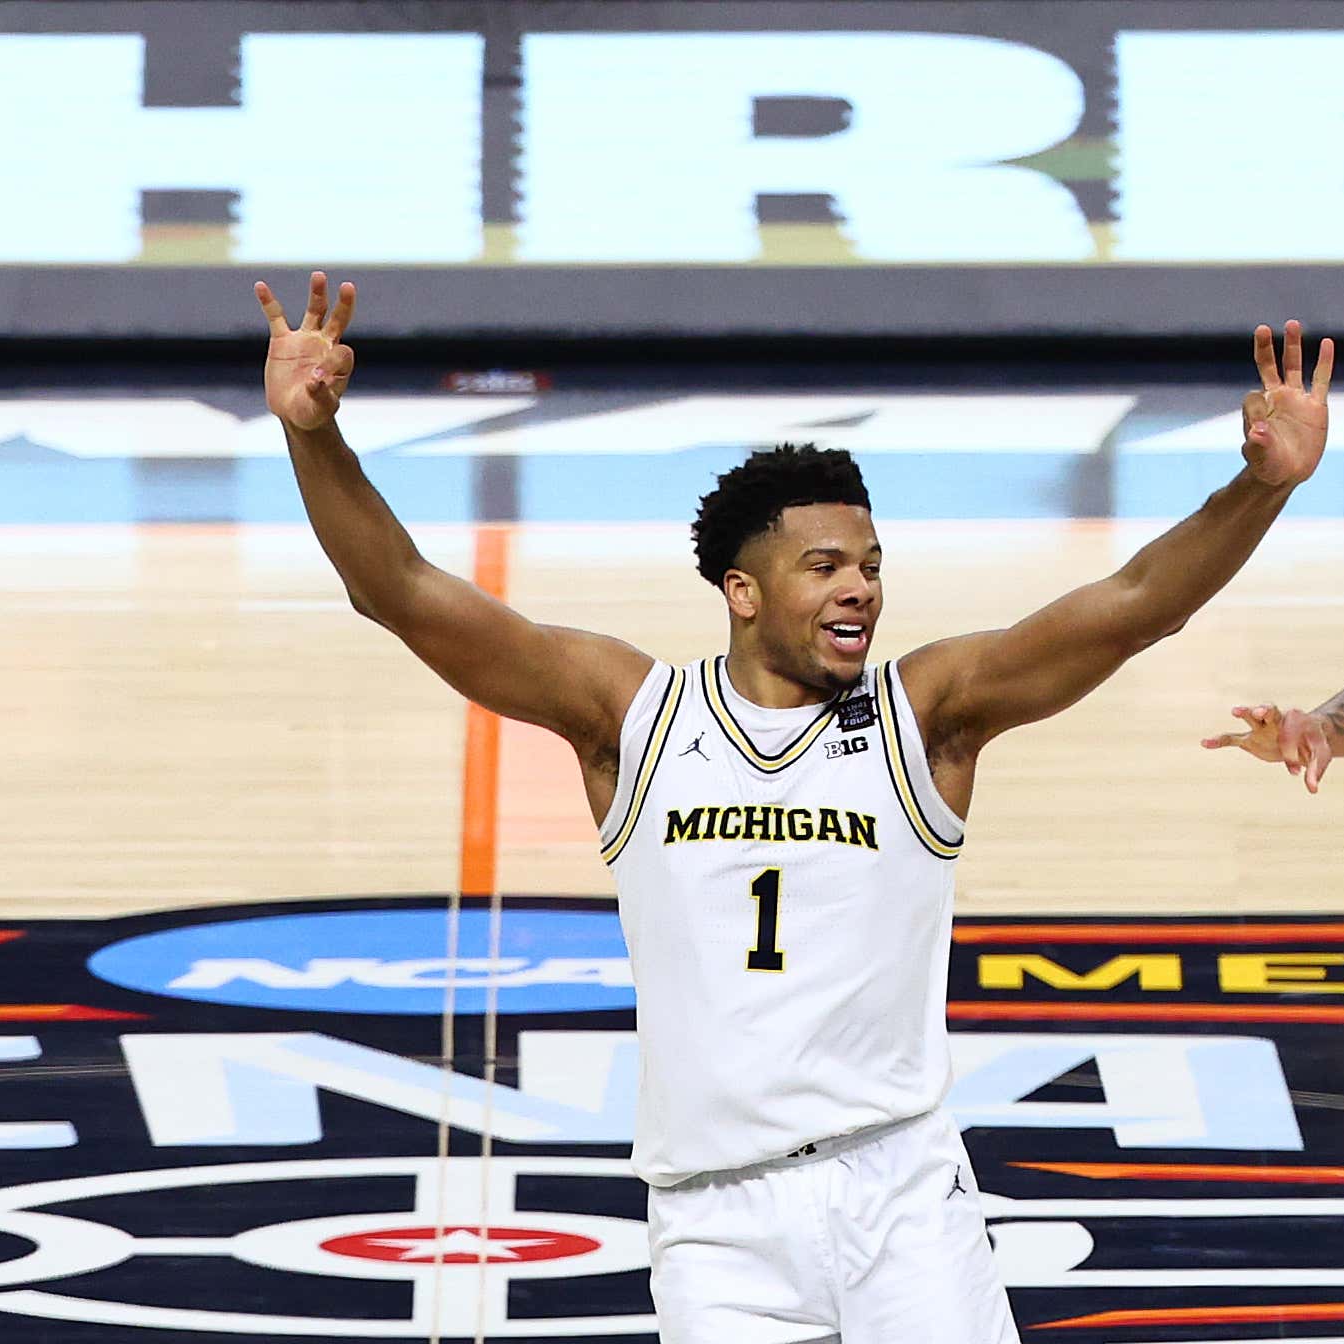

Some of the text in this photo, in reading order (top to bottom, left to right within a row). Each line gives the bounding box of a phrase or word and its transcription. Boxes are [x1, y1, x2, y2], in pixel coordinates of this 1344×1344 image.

[663, 806, 879, 851] MICHIGAN
[745, 865, 786, 973] 1
[167, 957, 634, 990] NCA
